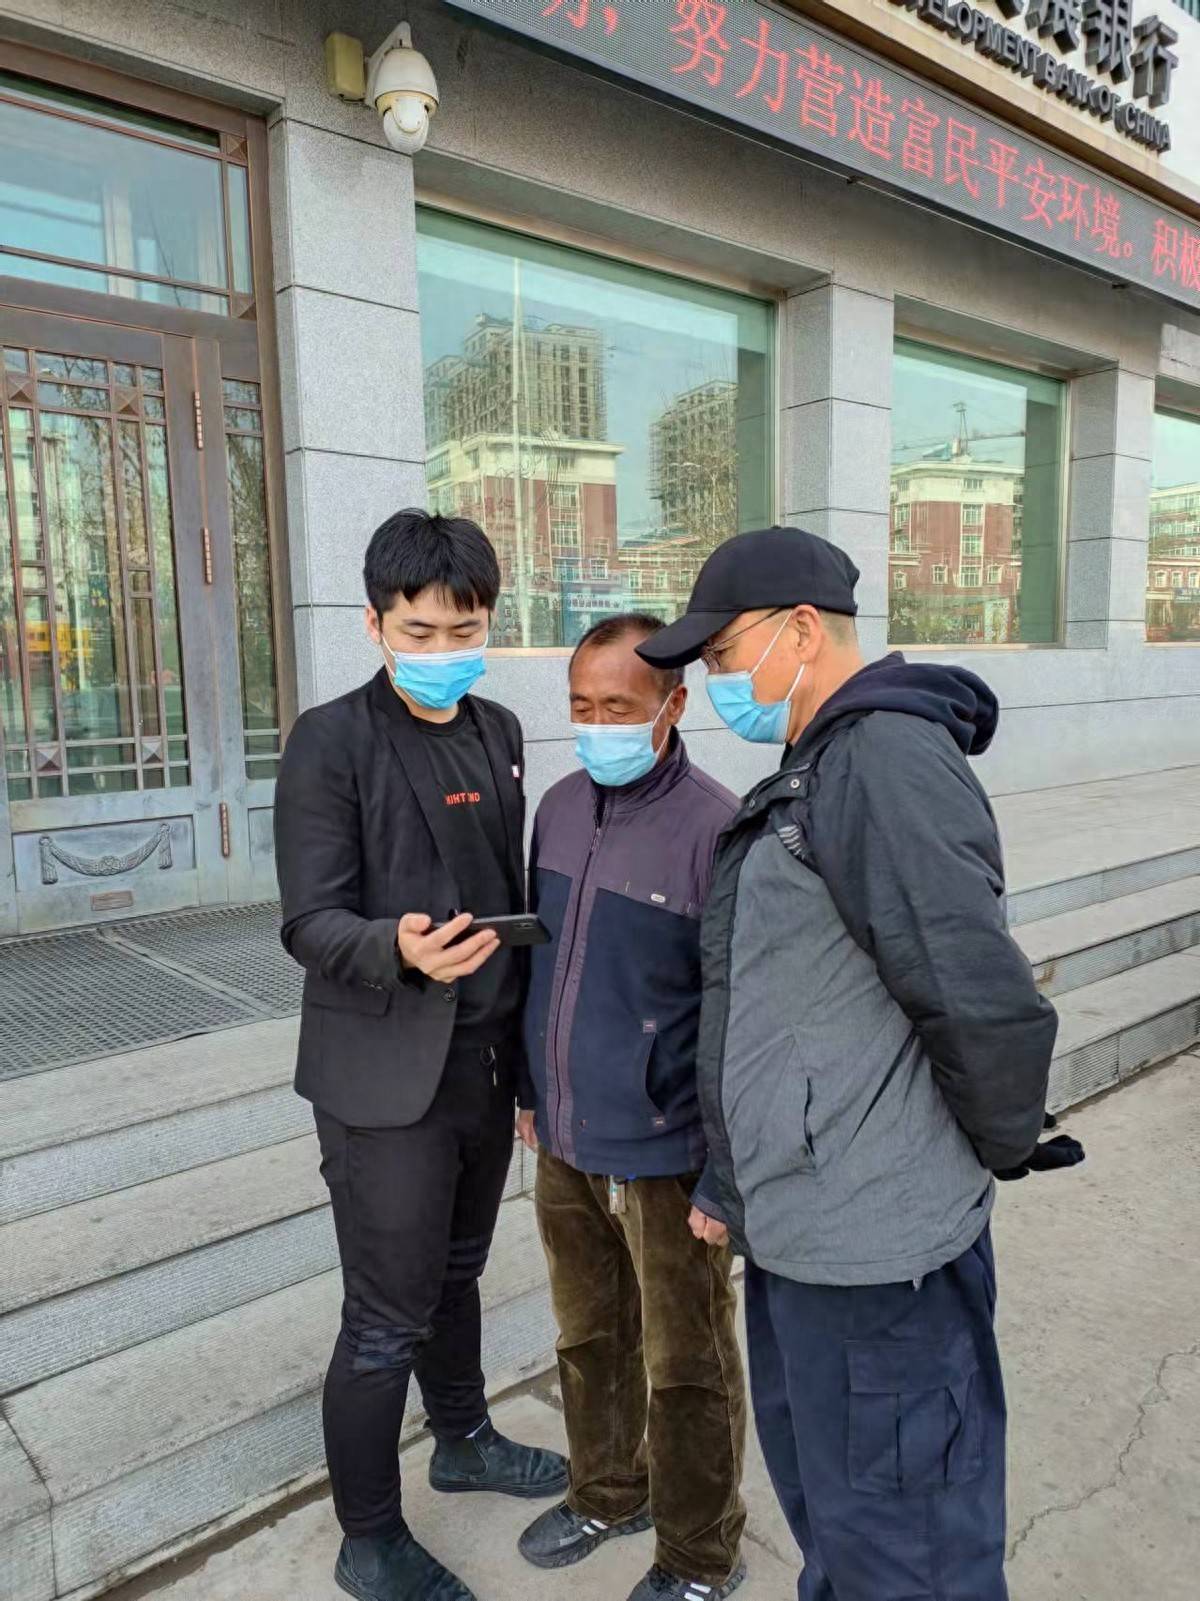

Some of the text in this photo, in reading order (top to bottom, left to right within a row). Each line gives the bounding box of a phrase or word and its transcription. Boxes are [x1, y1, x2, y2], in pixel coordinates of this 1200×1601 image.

[905, 0, 1171, 153] ELOPMENT BANK OF CHINA
